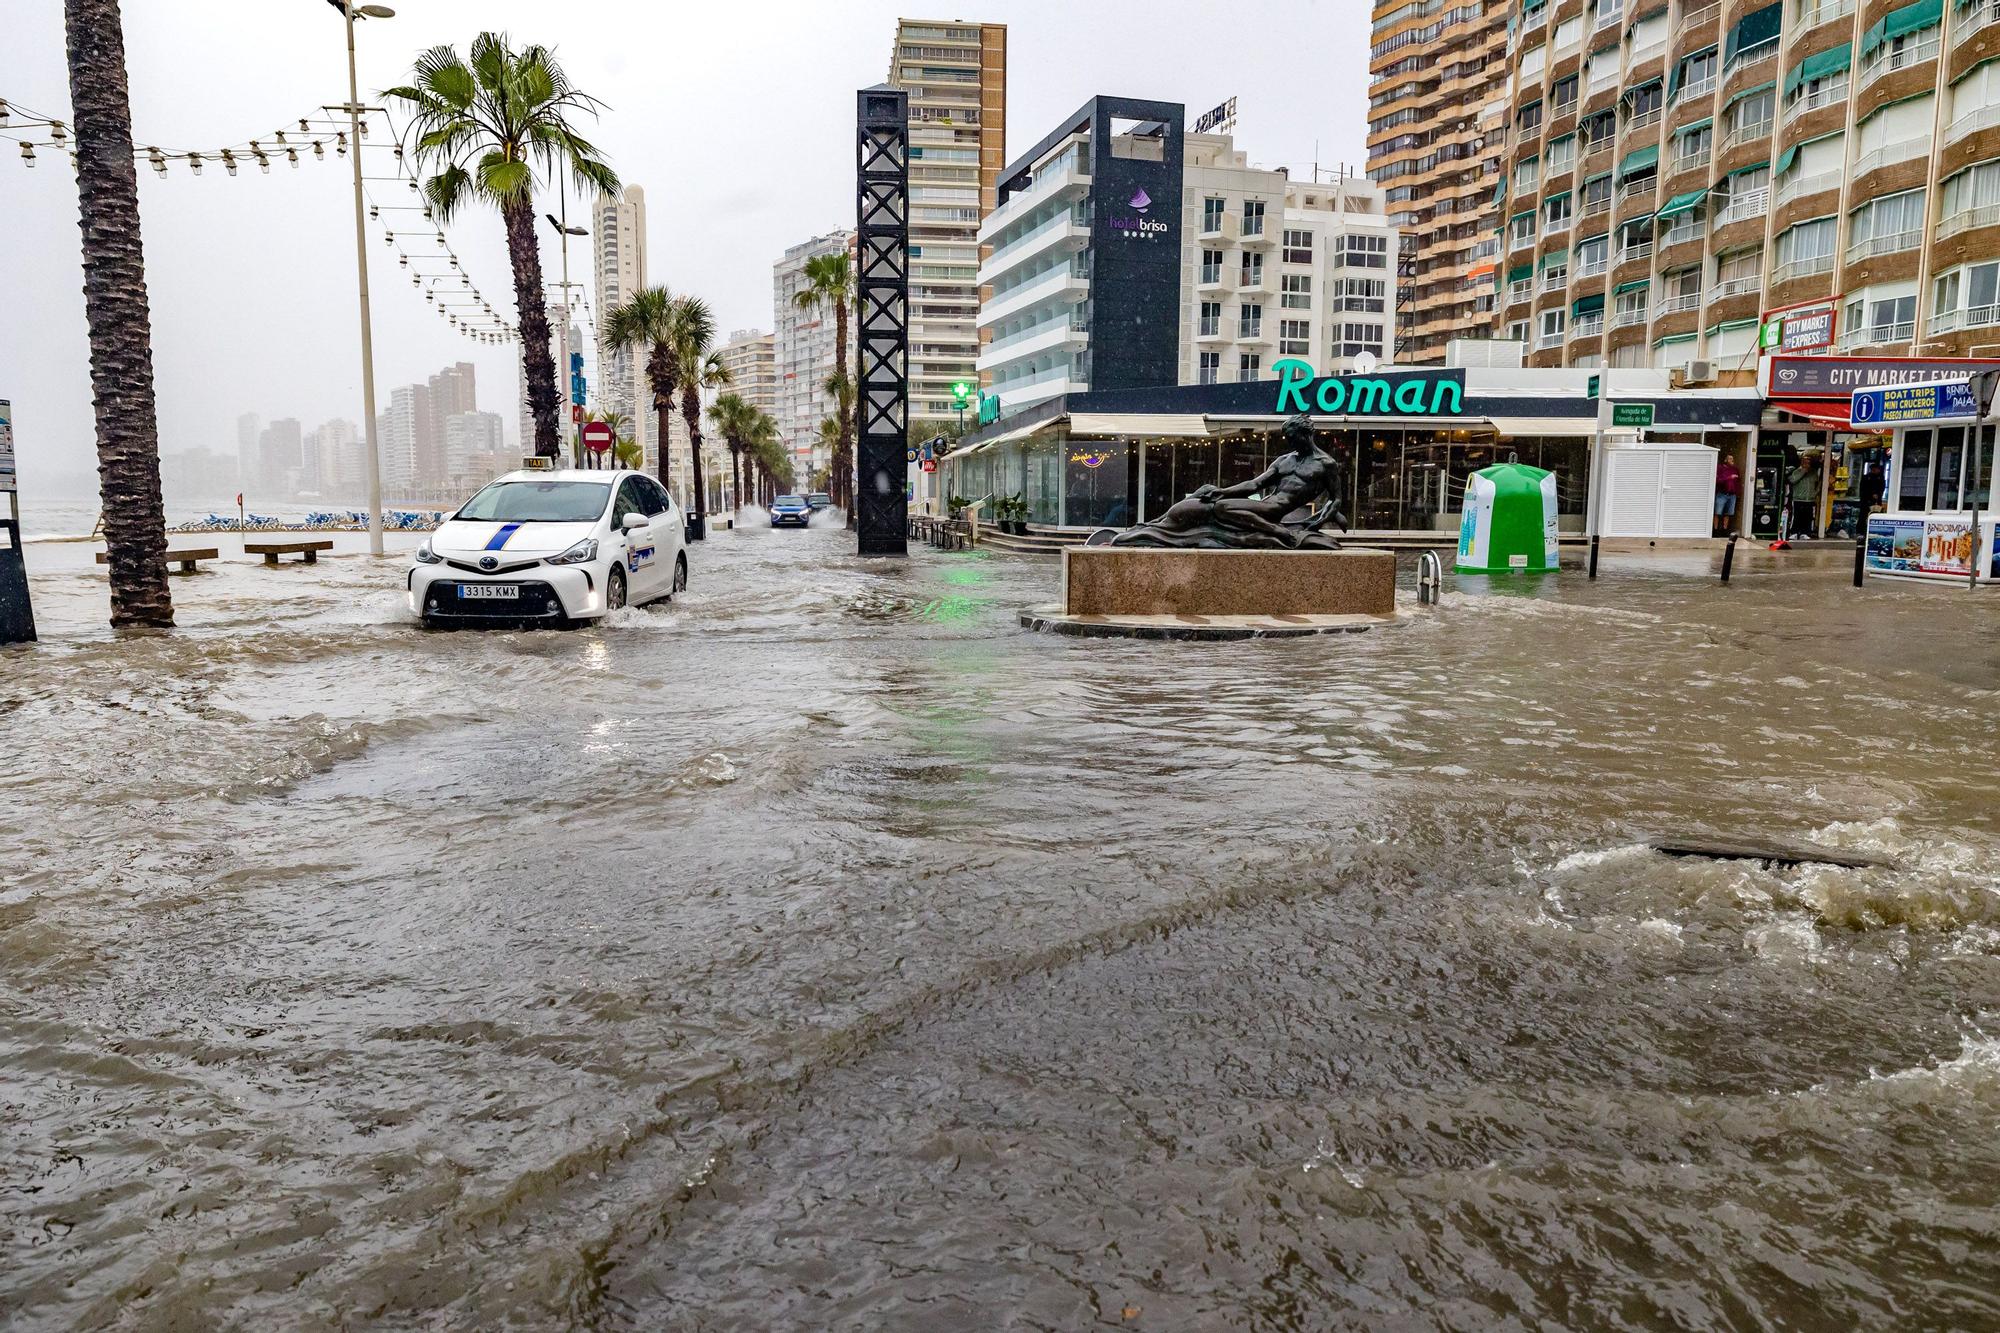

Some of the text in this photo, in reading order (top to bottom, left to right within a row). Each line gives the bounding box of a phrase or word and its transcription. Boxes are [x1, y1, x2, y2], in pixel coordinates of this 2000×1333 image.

[1786, 314, 1829, 335] CITY MARKET
[1791, 331, 1820, 348] EXPRESS
[1830, 369, 1862, 385] CITY
[1867, 370, 1926, 385] MARKET
[1271, 358, 1463, 413] Roman
[1884, 387, 1935, 400] BOAT TRIPS
[1884, 397, 1936, 410] MINI CRUCEROS
[1883, 409, 1902, 420] PASEOS
[529, 459, 543, 467] TAXI
[466, 587, 516, 596] 3315 KMX
